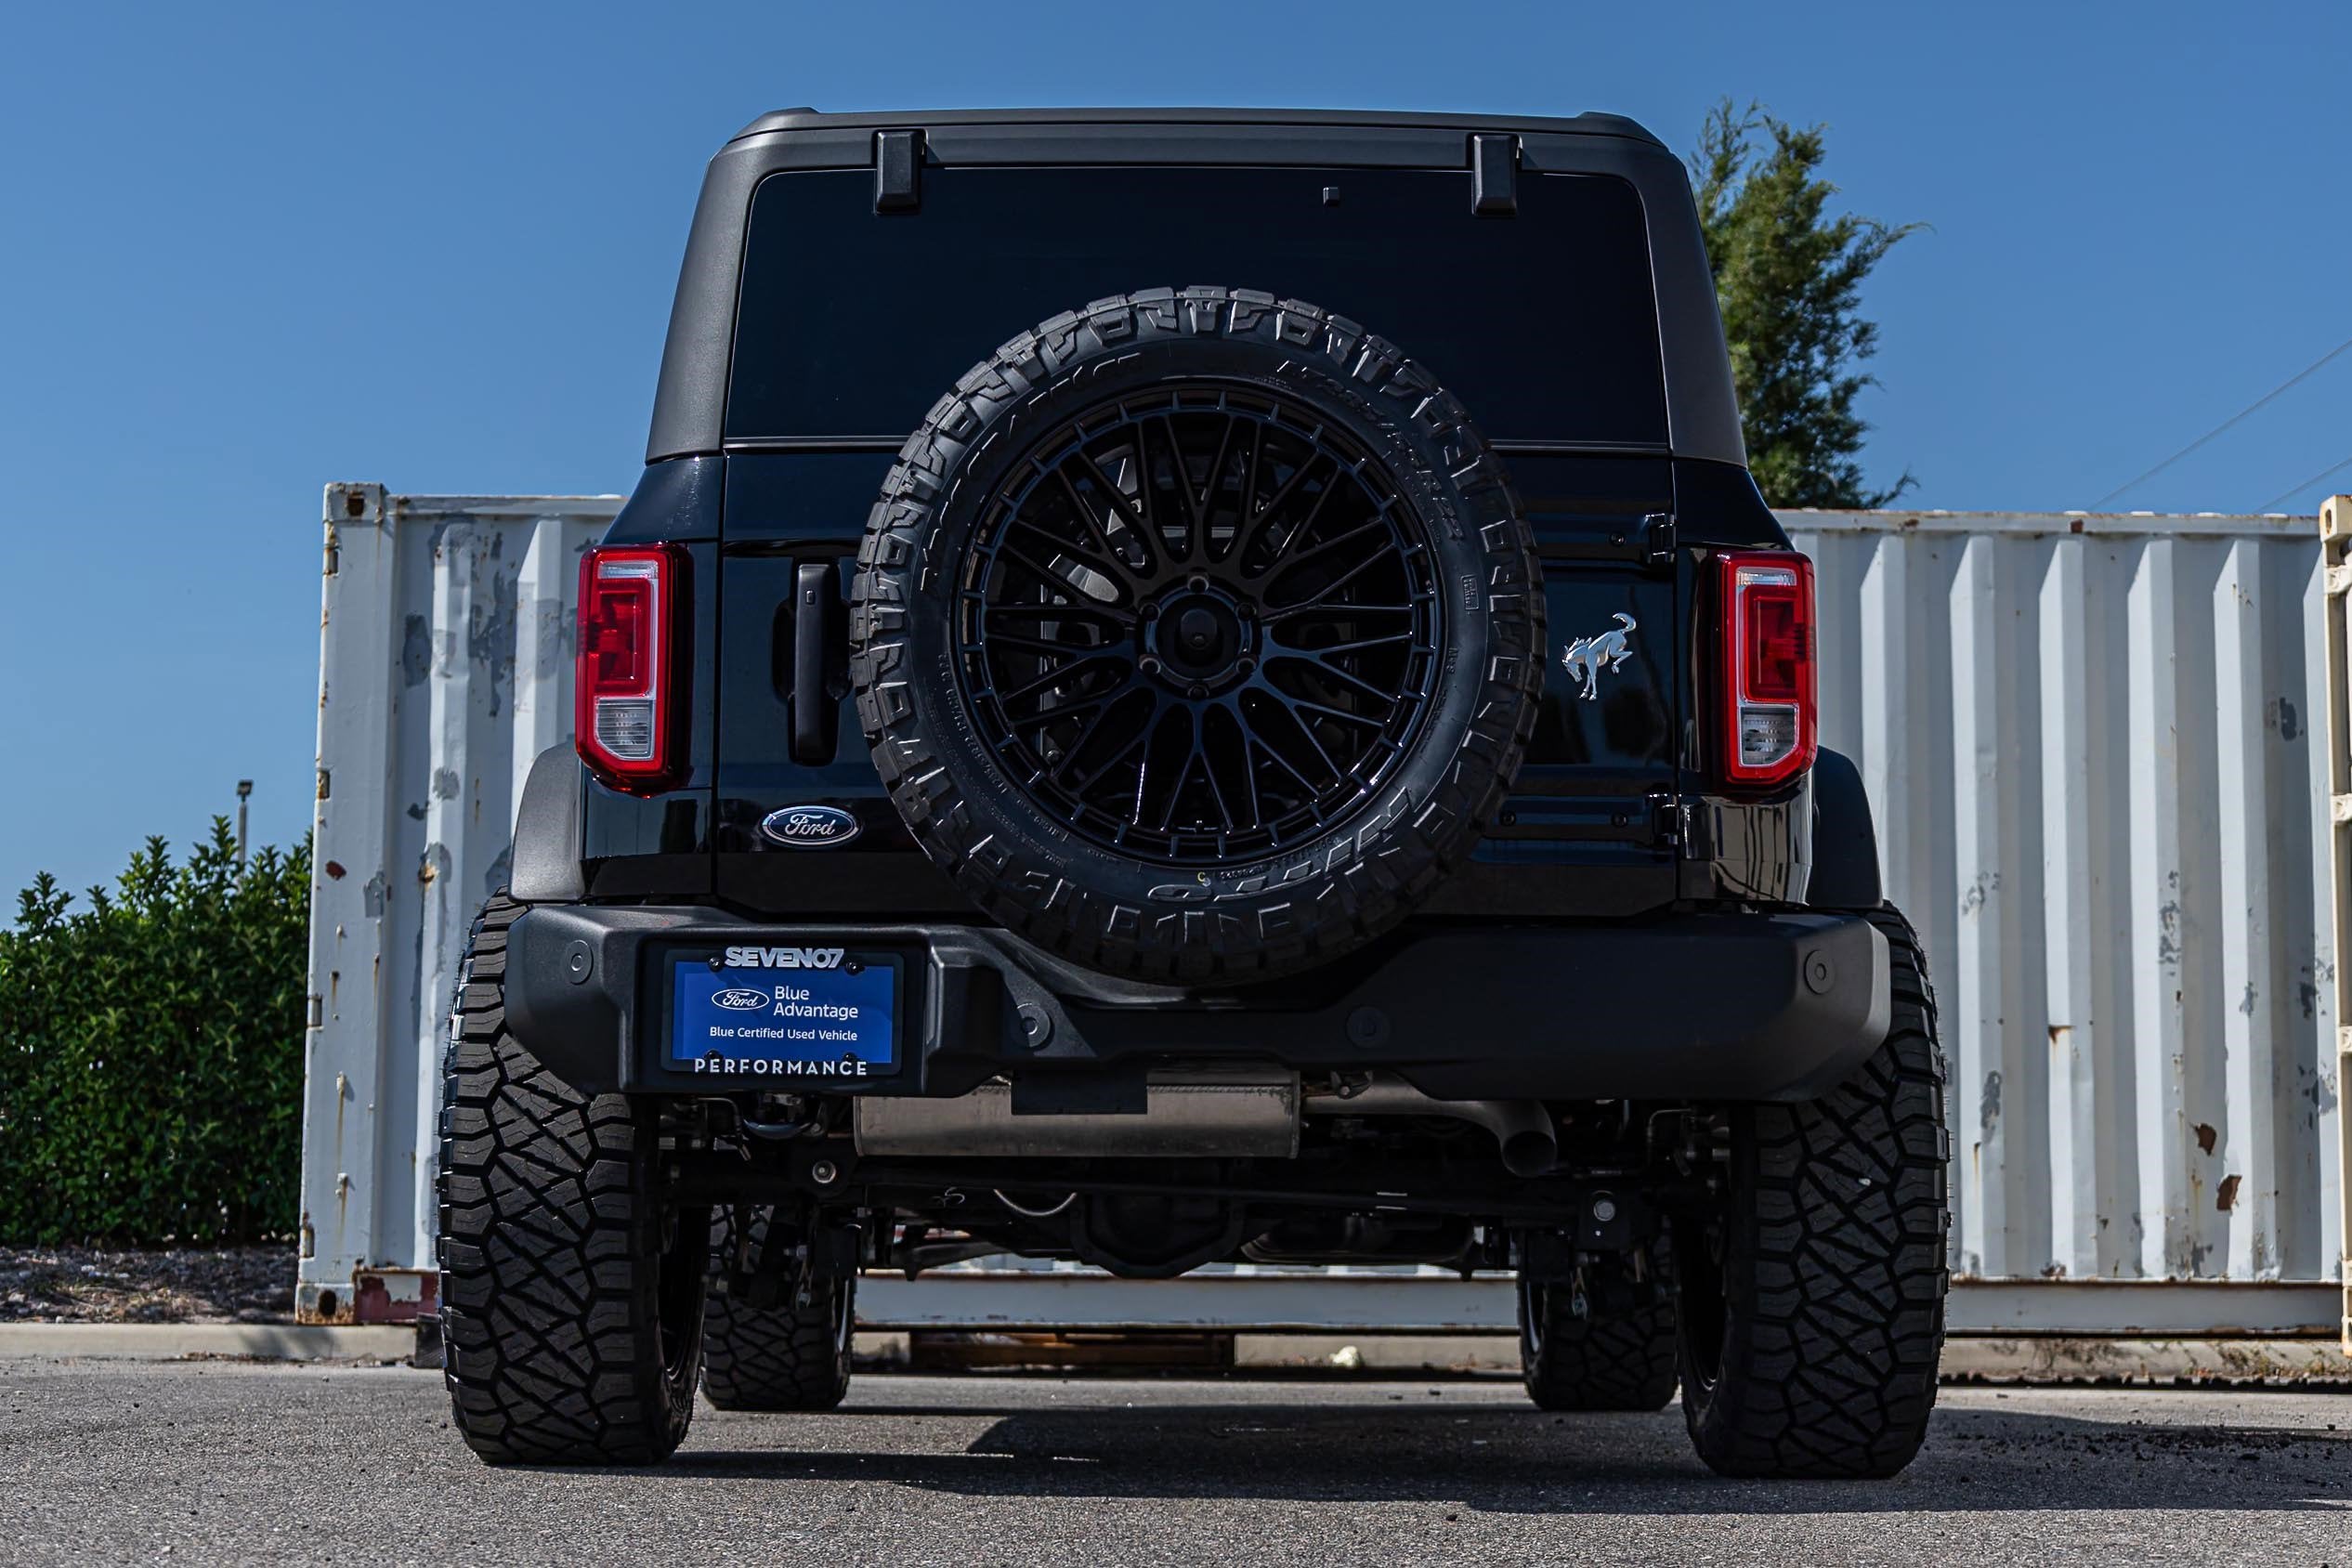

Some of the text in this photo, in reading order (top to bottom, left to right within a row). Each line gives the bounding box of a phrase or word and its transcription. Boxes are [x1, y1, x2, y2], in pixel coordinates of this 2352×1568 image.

[785, 814, 837, 835] Ford
[722, 991, 758, 1008] Ford
[775, 986, 810, 1001] Blue
[773, 1002, 858, 1020] Advantage
[710, 1026, 858, 1041] Blue Certified Used Vehicle
[694, 1058, 867, 1076] PERFORMANCE
